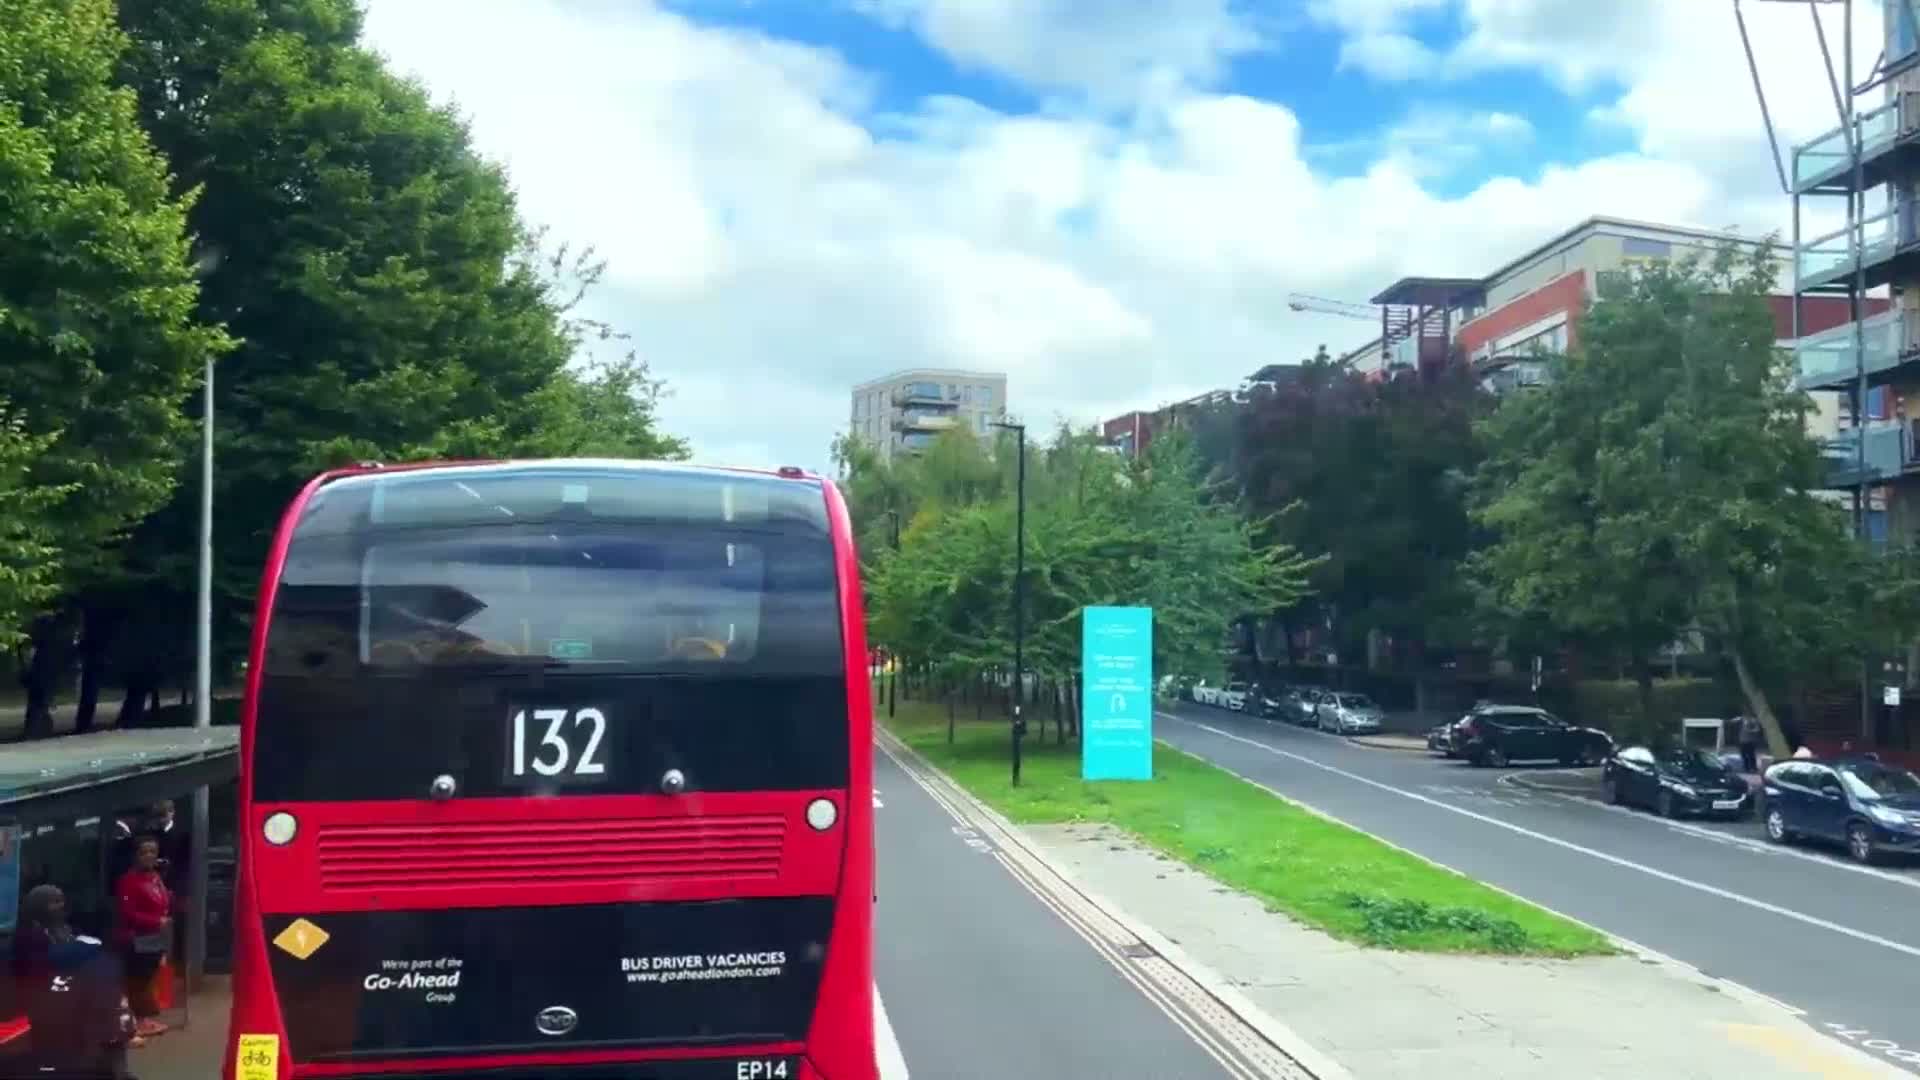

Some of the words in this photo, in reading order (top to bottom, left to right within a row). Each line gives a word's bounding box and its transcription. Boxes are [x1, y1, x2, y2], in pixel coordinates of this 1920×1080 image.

[513, 707, 606, 776] 132
[411, 959, 433, 971] part
[621, 957, 650, 971] BUS
[652, 954, 703, 969] DRIVER
[706, 951, 786, 967] VACANCIES
[364, 970, 460, 990] Go-Ahead
[627, 966, 781, 983] www.goaheadlondon.com
[425, 991, 456, 1004] Group
[736, 1060, 788, 1080] EP14
